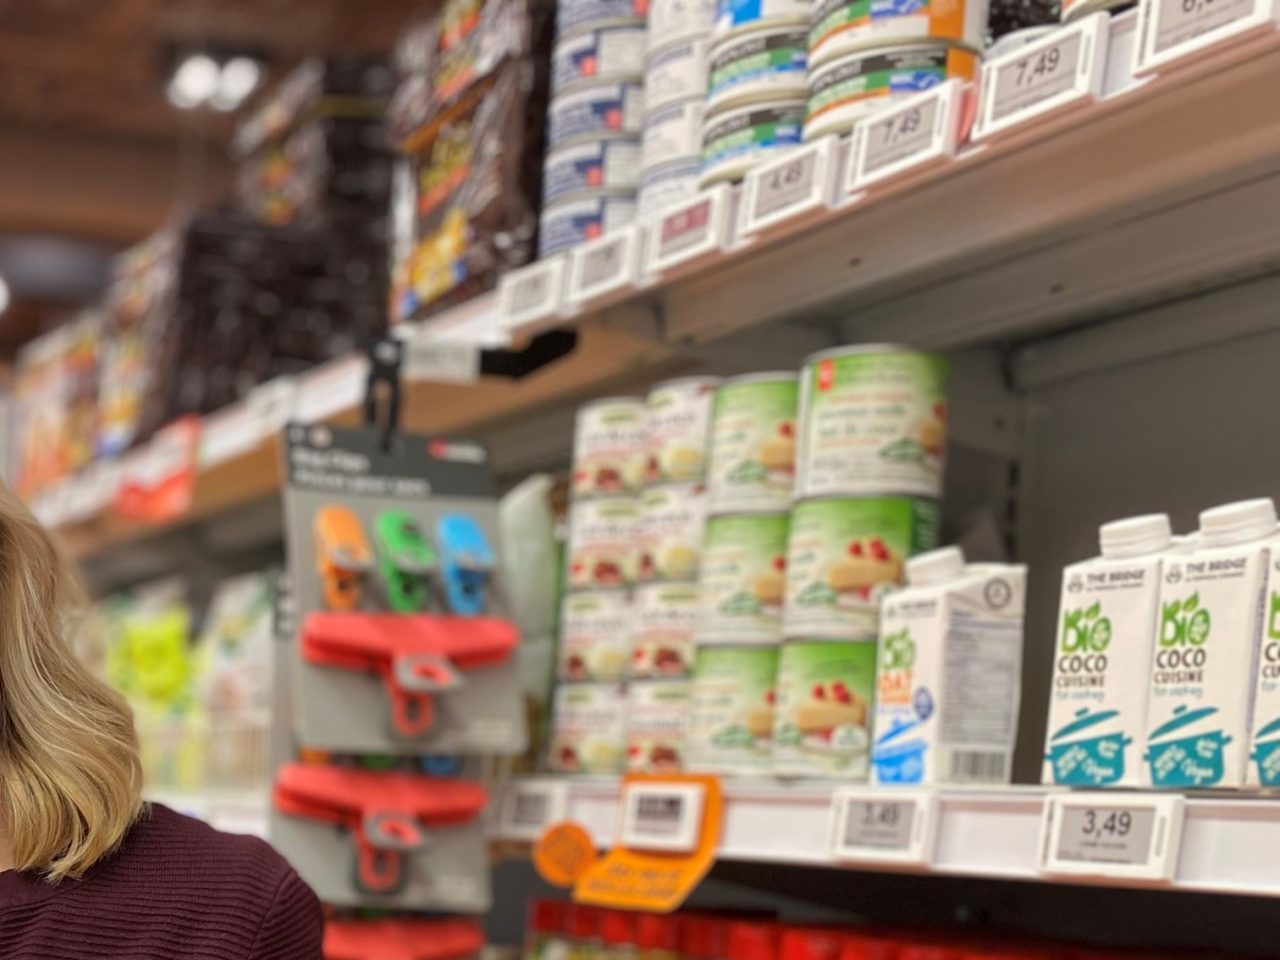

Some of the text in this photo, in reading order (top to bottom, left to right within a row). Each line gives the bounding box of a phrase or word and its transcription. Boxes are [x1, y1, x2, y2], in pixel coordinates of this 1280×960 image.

[1015, 47, 1060, 88] 7,49
[1185, 557, 1248, 574] THE BRIDGE
[1086, 569, 1145, 584] THE BRIDGE
[1057, 654, 1108, 674] COCO
[1156, 648, 1207, 670] COCO
[1055, 675, 1106, 689] CUISINE
[1153, 669, 1204, 685] CUISINE
[1081, 809, 1132, 838] 3,49
